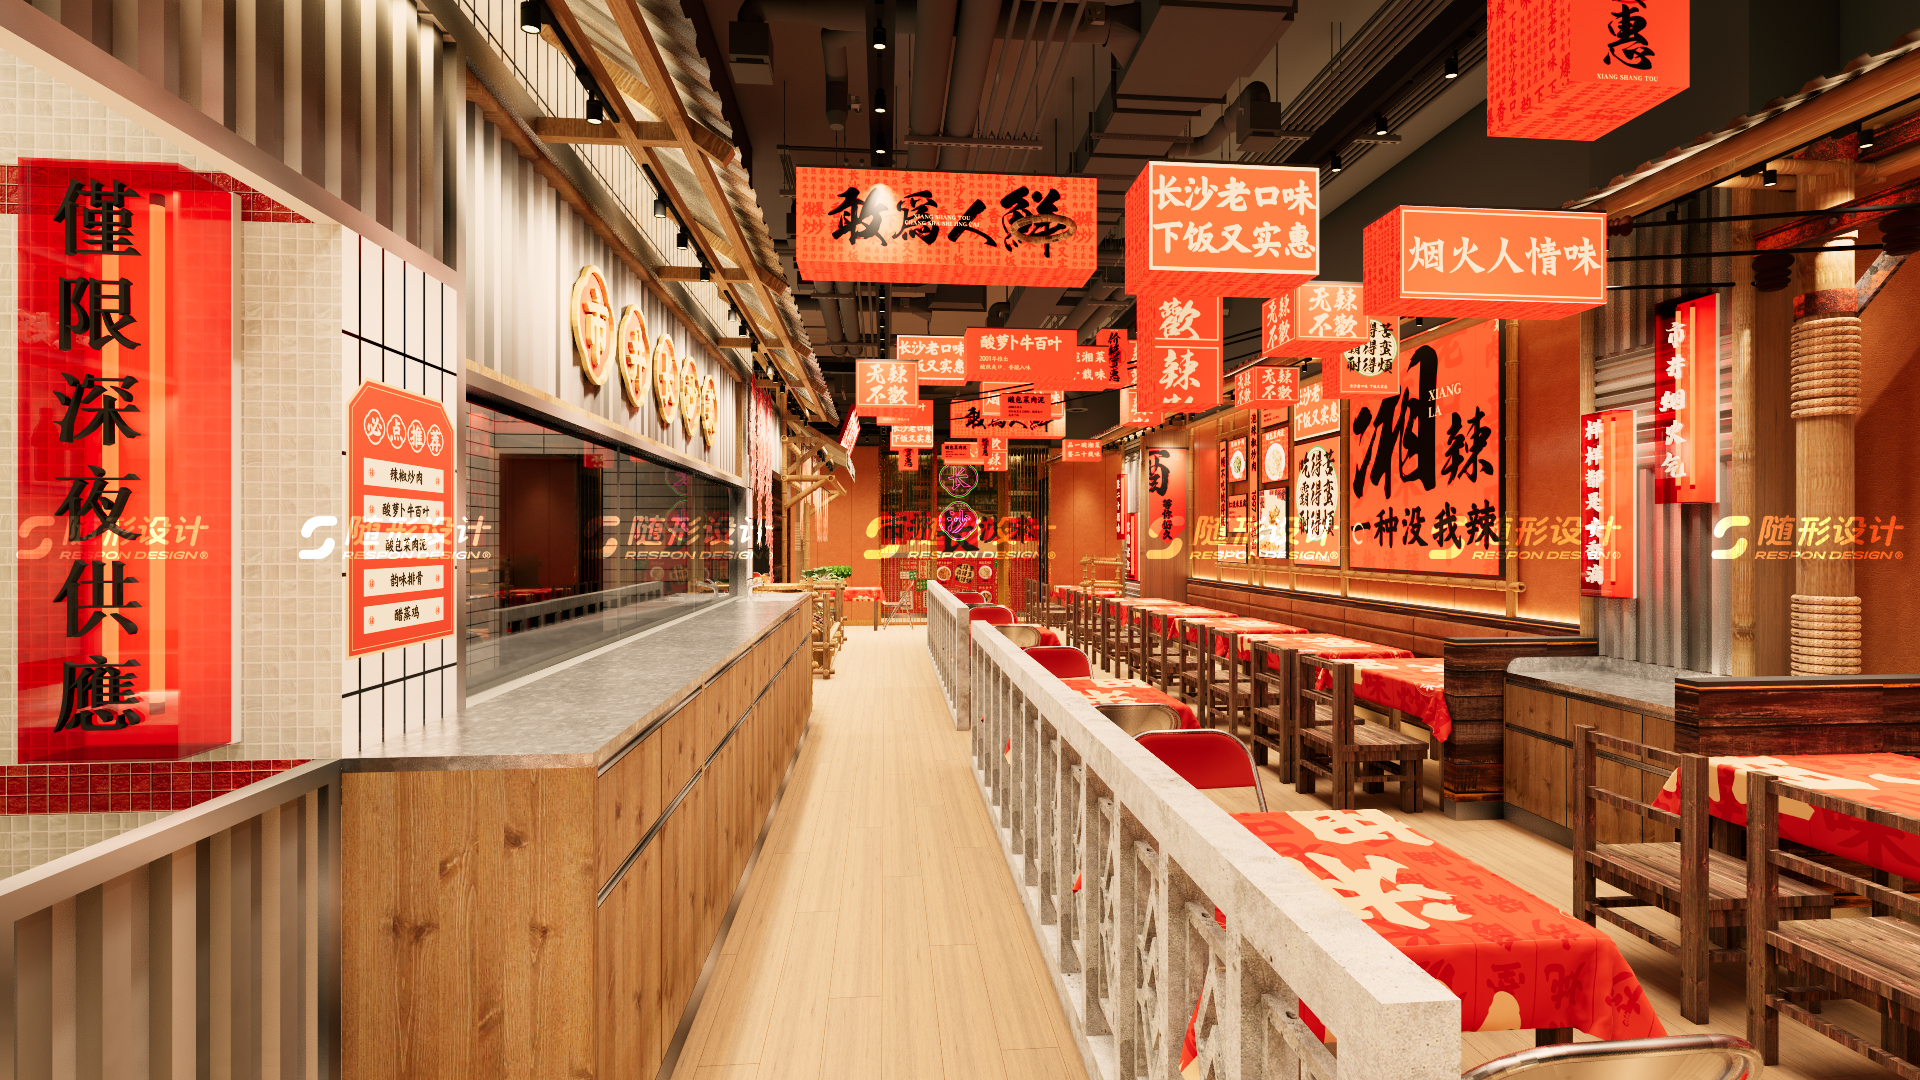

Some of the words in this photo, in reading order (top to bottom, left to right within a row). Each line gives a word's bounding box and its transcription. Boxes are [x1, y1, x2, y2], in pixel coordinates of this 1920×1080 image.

[1603, 0, 1655, 70] 惠
[1620, 74, 1643, 82] SHANG
[1152, 174, 1317, 215] 长沙老口味
[1152, 221, 1316, 259] 下饭又实惠
[1407, 236, 1602, 276] 烟火人情味
[898, 340, 964, 356] 长沙老口味
[980, 334, 1063, 352] 酸萝卜牛百叶
[1427, 382, 1462, 402] XIANG
[1295, 401, 1339, 432] 下饭又实惠
[1427, 406, 1442, 418] LA
[366, 416, 443, 452] 必点推荐
[53, 178, 144, 733] 僅限深夜供應
[389, 467, 424, 486] 辣椒炒肉
[382, 502, 430, 518] 酸萝卜牛百叶
[1350, 499, 1500, 550] 一种没我辣
[390, 571, 424, 588] 韵味排骨
[394, 604, 420, 622] 醋蒸鸡
